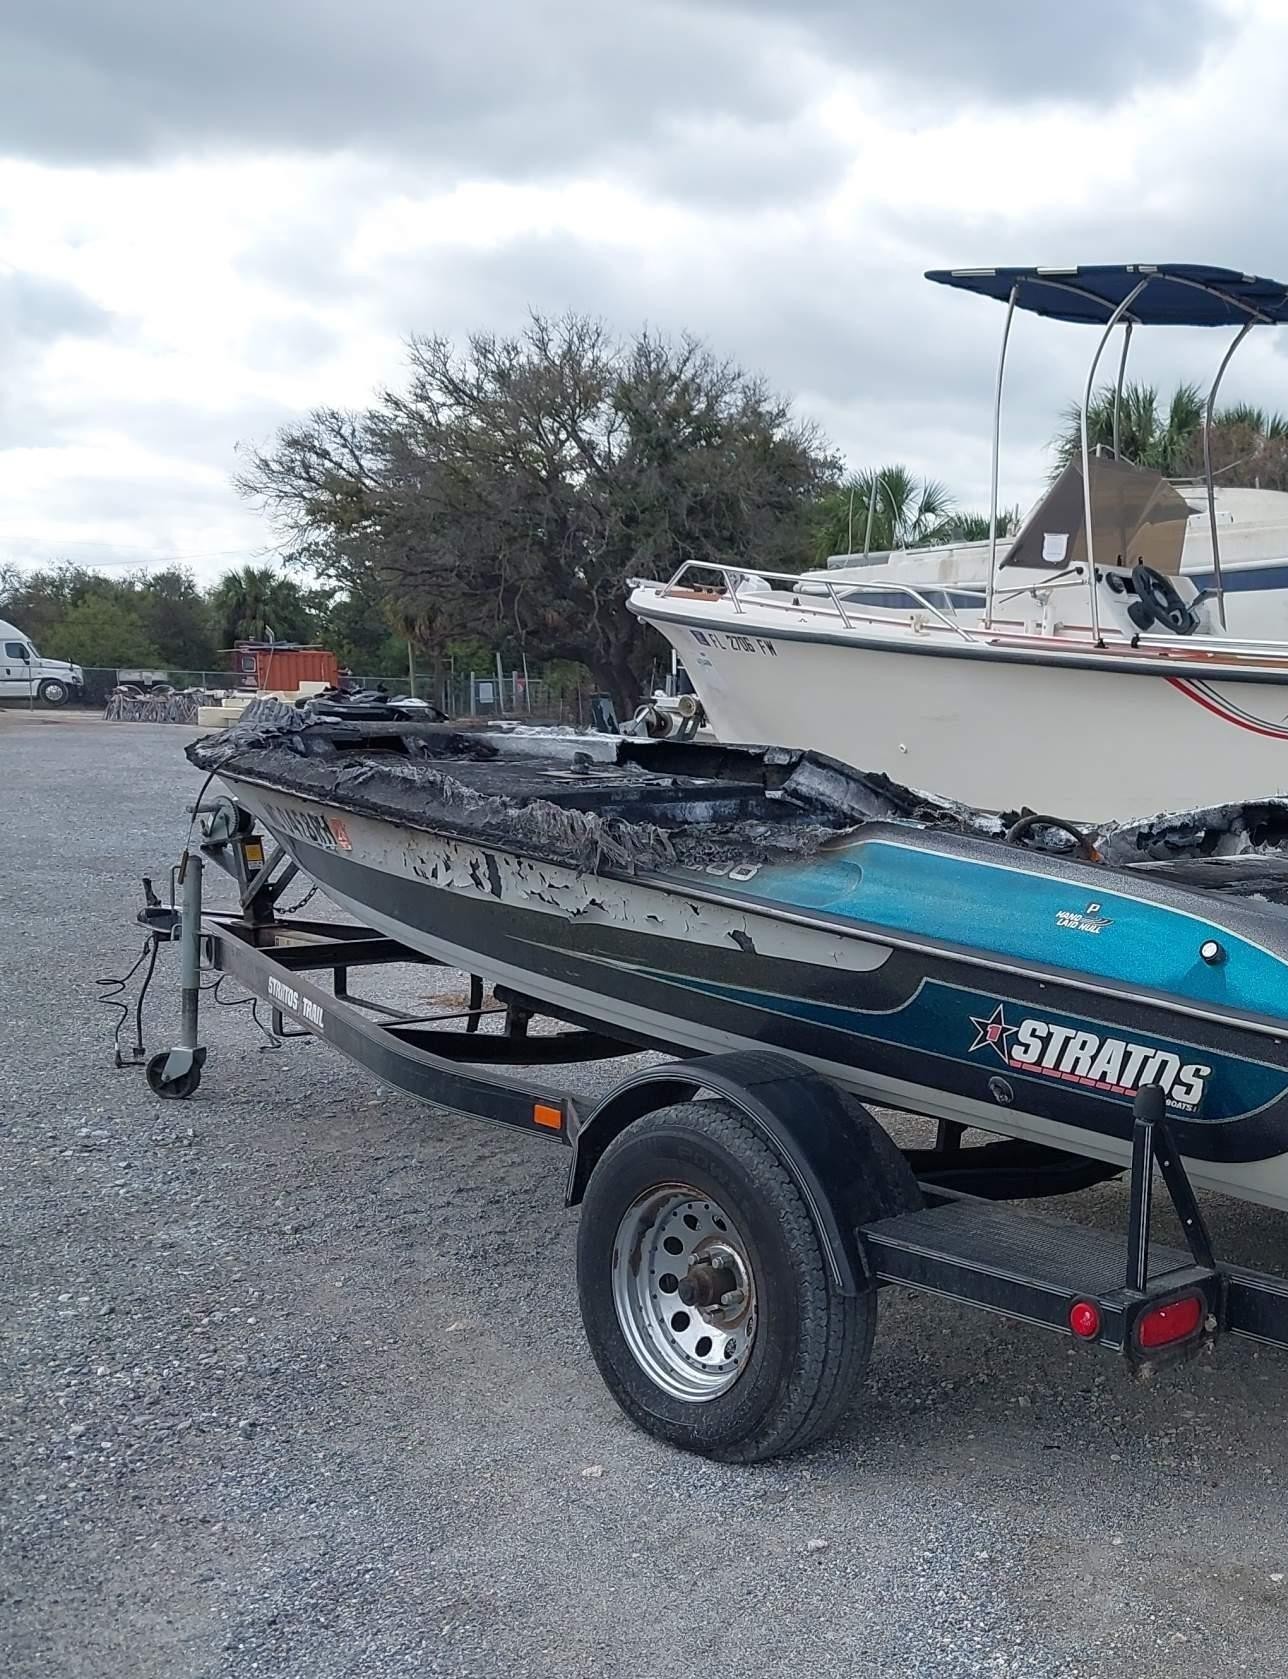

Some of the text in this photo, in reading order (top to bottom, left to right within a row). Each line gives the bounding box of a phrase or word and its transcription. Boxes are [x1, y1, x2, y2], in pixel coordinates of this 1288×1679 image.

[708, 633, 727, 650] FL
[725, 634, 756, 653] 2706
[756, 639, 778, 656] FW
[1056, 910, 1083, 921] HAND
[1056, 918, 1079, 928] LAID
[986, 1024, 1002, 1042] 1
[1011, 1019, 1212, 1104] STRATOS
[1165, 1098, 1193, 1112] BOATS
